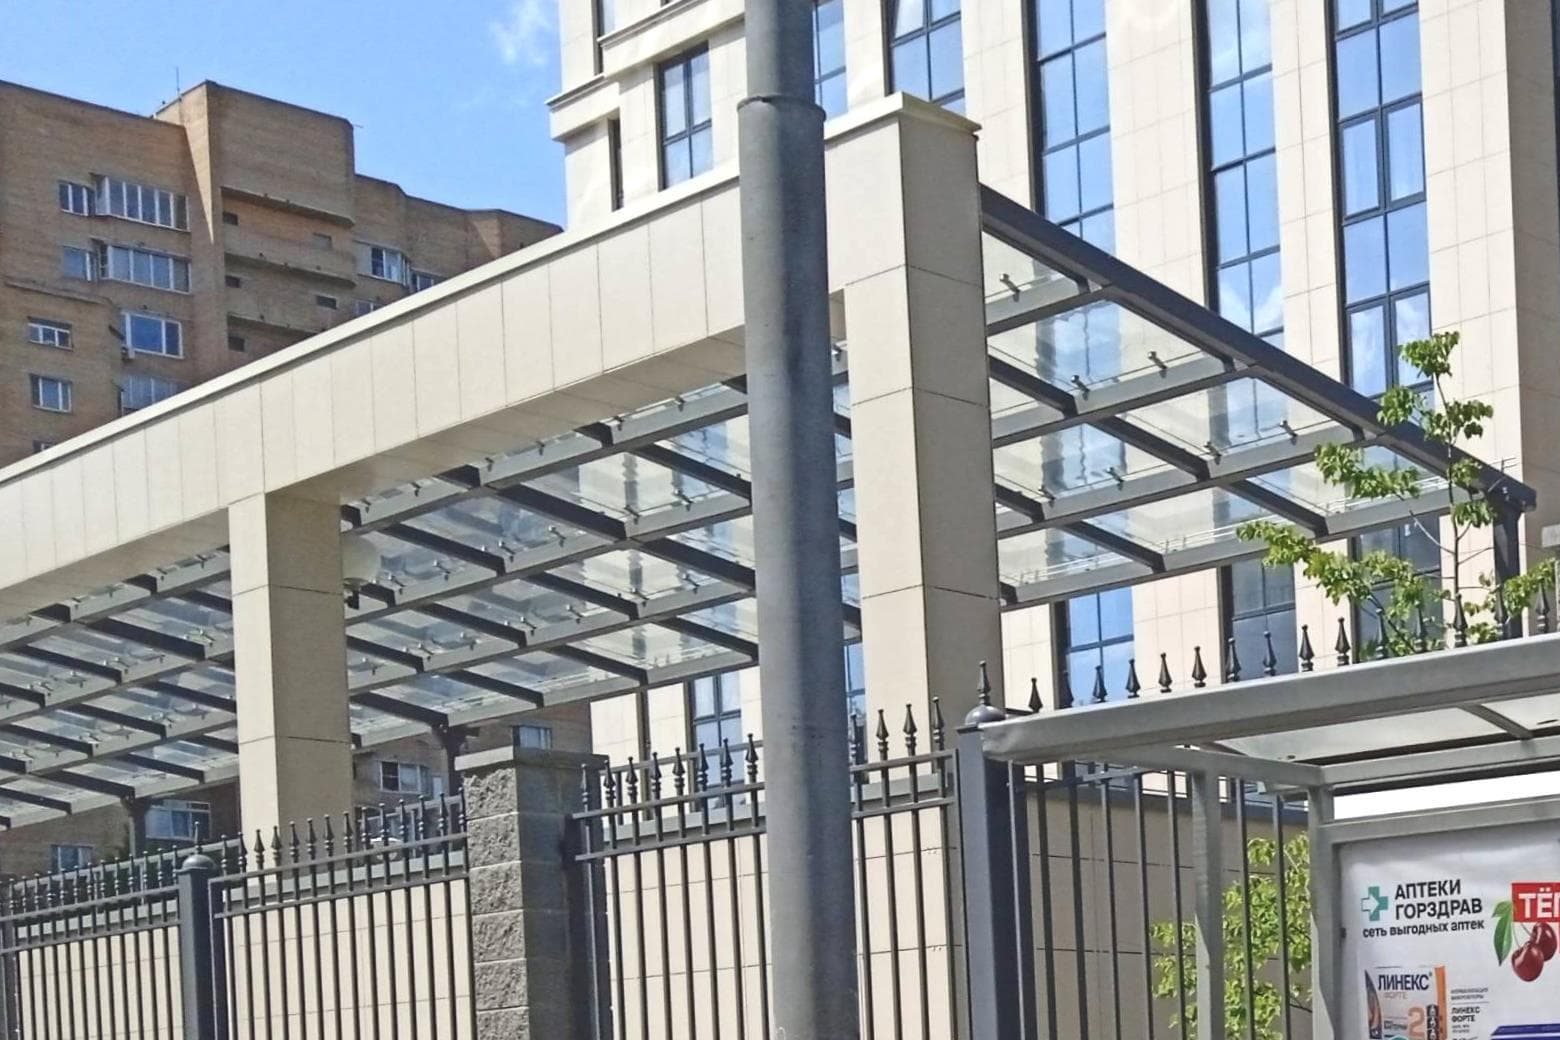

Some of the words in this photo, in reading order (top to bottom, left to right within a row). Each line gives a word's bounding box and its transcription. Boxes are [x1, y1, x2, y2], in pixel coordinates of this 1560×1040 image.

[1394, 879, 1461, 900] АПТЕКИ
[1395, 898, 1483, 921] ГОРЗДРАВ
[1362, 927, 1387, 938] сеть
[1389, 922, 1449, 937] выгодных
[1451, 918, 1485, 933] аптек
[1378, 973, 1430, 991] ЛИНЕКС
[1451, 1006, 1480, 1014] ЛИНЕКС
[1451, 1014, 1476, 1022] ФОРТЕ
